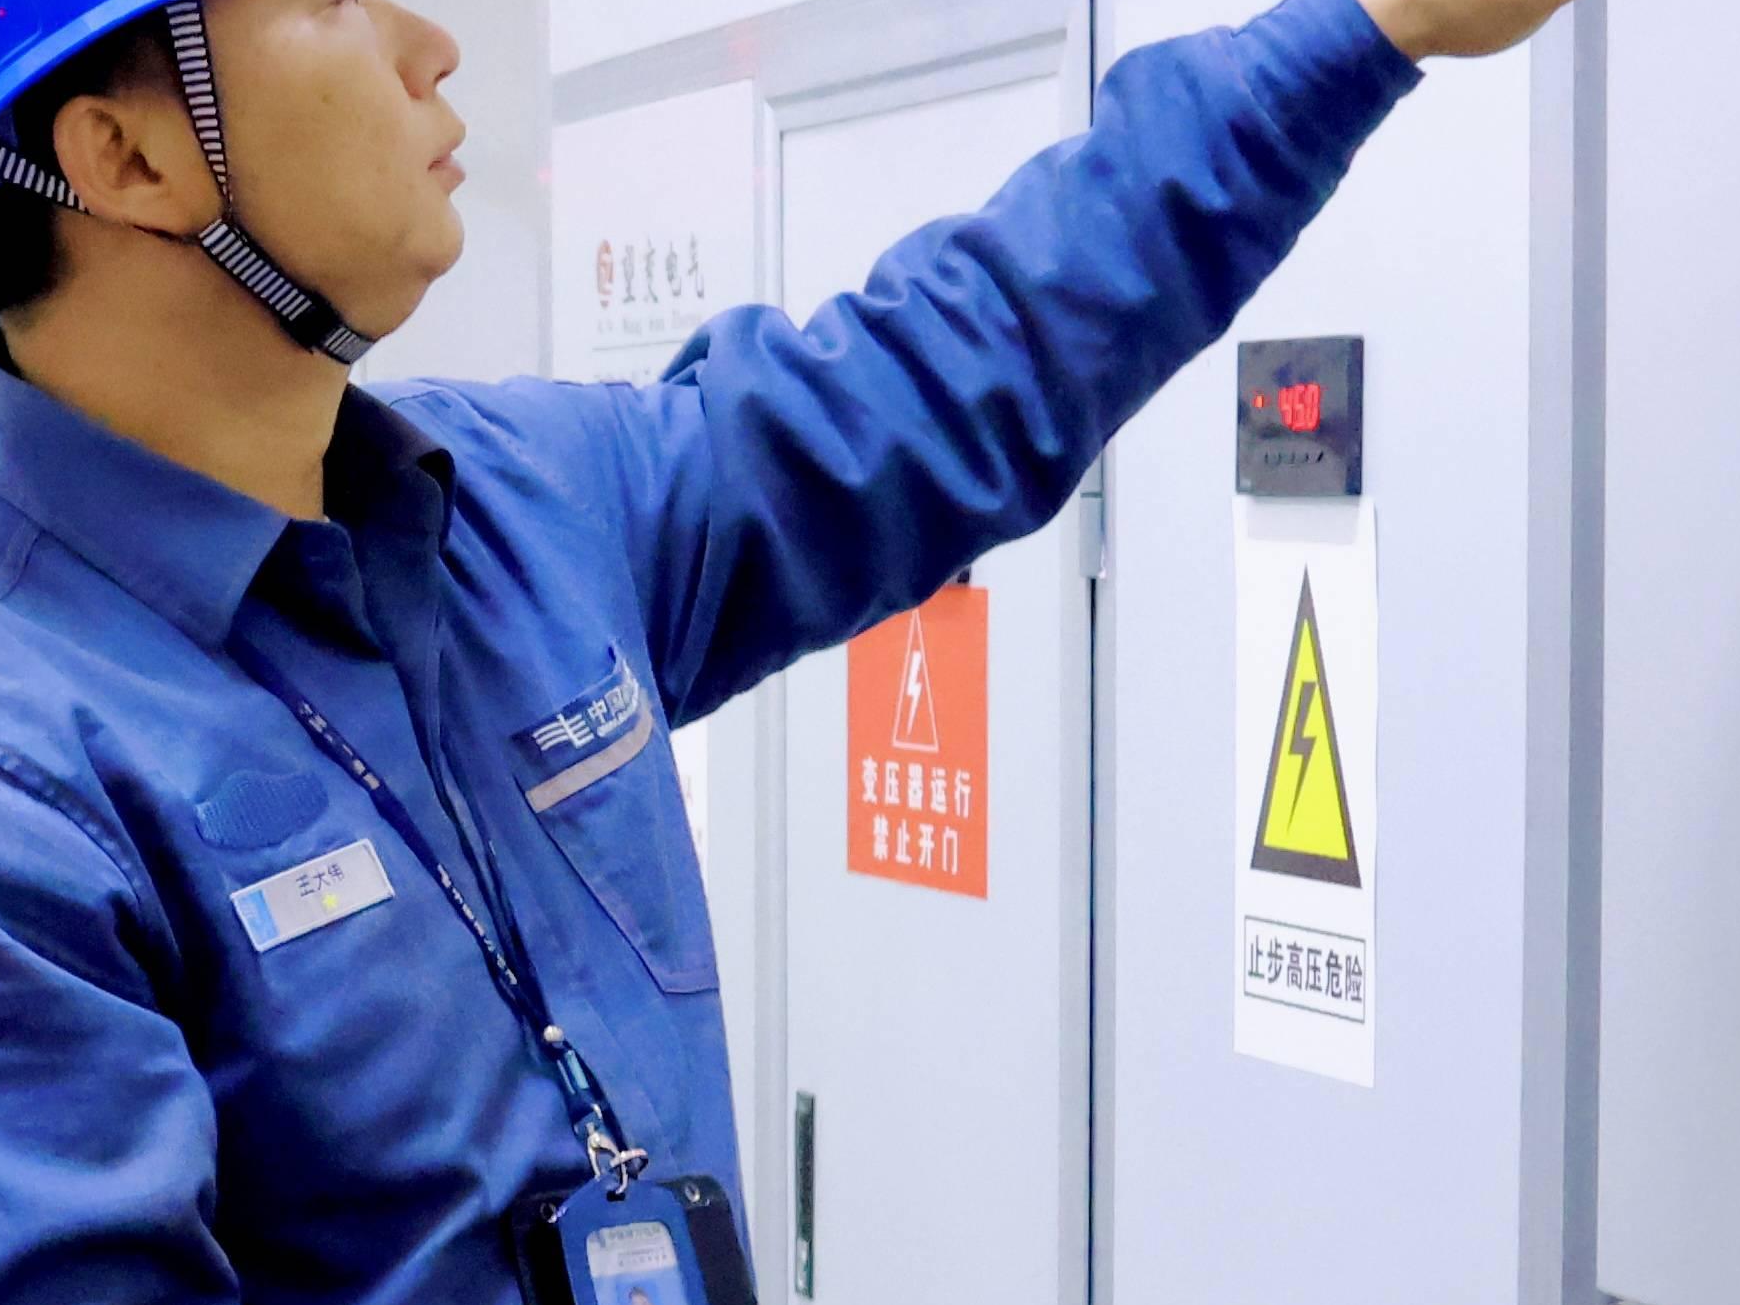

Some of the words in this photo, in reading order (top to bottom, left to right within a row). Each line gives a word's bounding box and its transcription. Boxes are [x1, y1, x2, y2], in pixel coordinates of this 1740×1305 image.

[862, 755, 972, 819] 变压器运行
[873, 814, 959, 875] 禁止开门
[1247, 934, 1363, 1002] 止步高压危险
